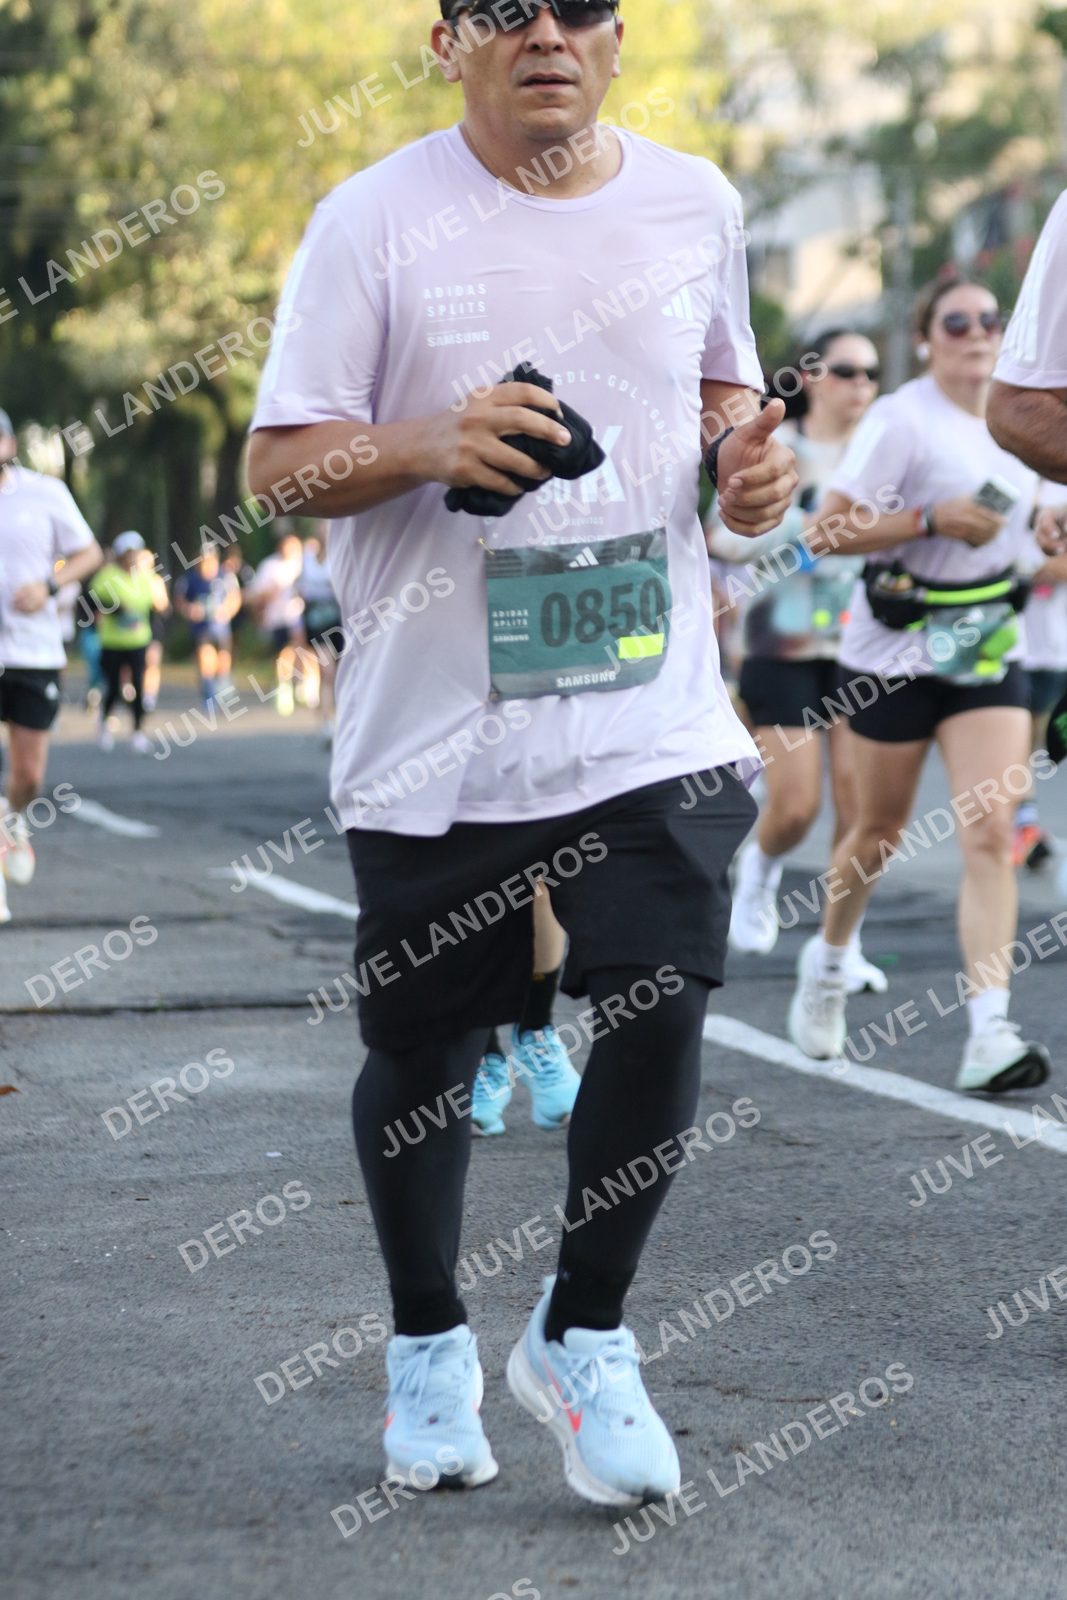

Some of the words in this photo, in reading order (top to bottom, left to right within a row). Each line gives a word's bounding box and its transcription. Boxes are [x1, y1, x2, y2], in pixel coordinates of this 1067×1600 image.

[423, 283, 487, 299] ADIDAS
[427, 301, 486, 317] SPLITS
[426, 331, 490, 347] SAMSUNG
[554, 370, 587, 386] GDL
[607, 374, 638, 398] GDL
[492, 609, 529, 617] ADIDAS
[540, 577, 666, 648] 0850
[556, 670, 617, 688] SAMSUNG
